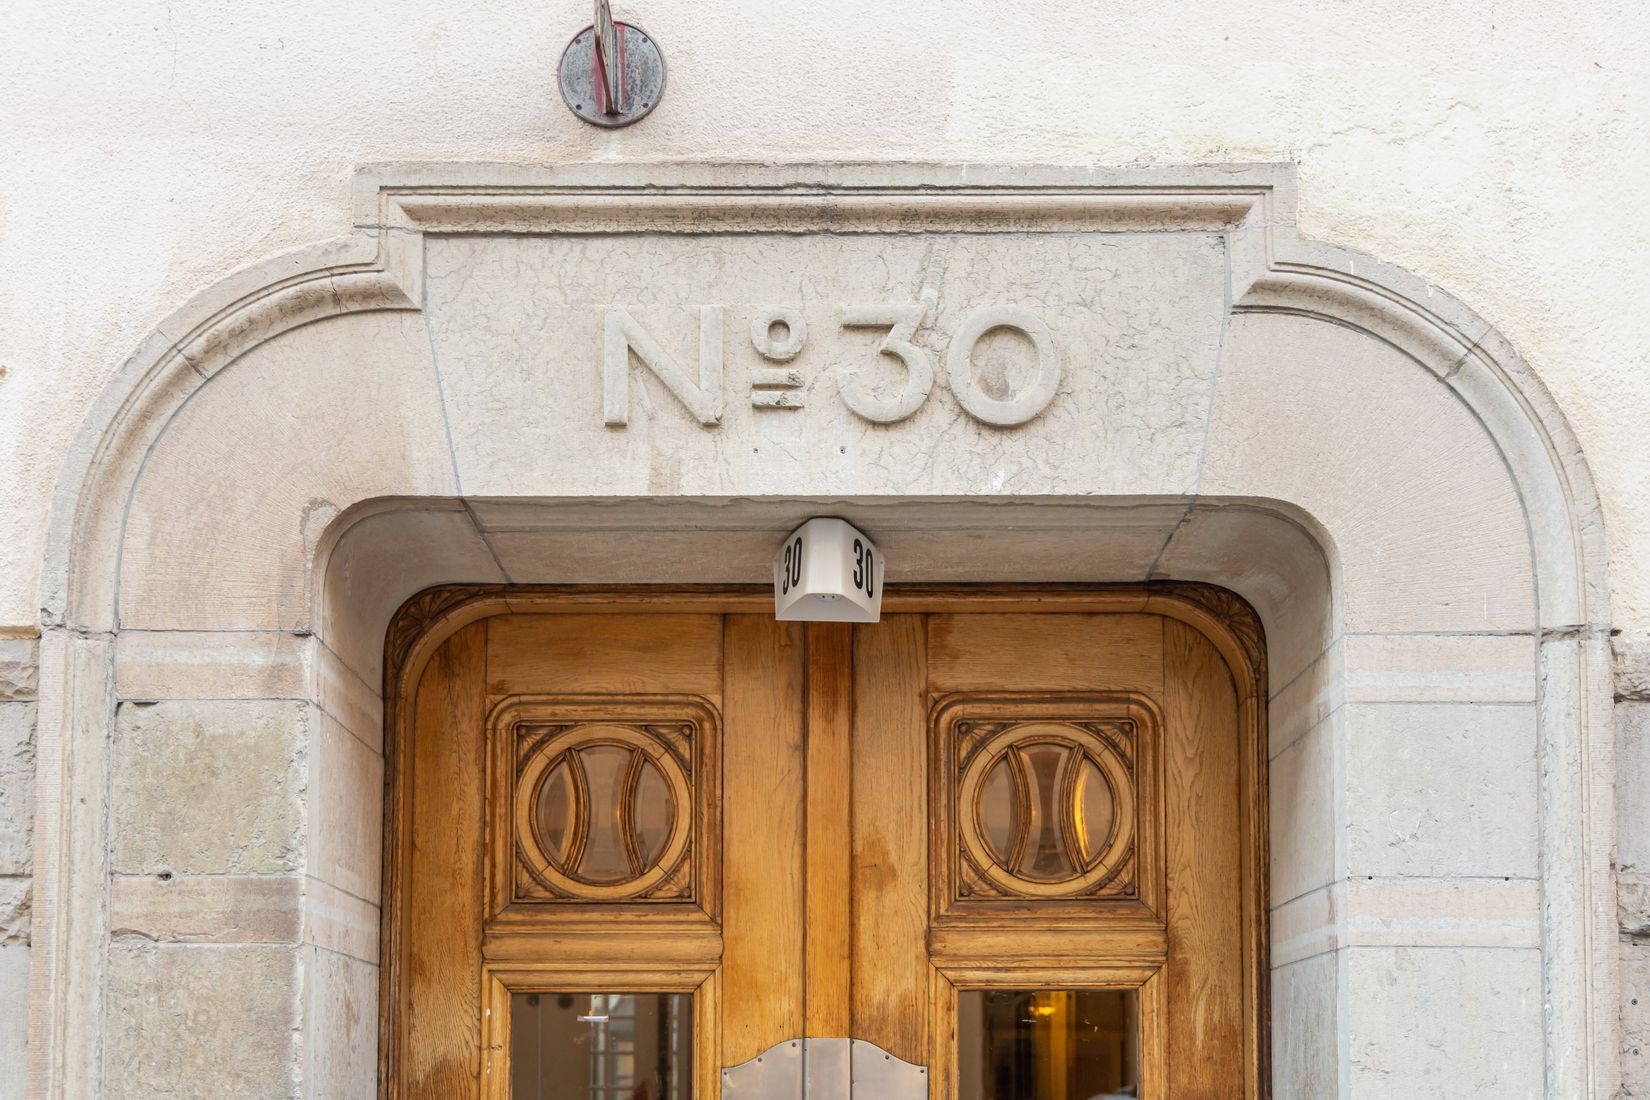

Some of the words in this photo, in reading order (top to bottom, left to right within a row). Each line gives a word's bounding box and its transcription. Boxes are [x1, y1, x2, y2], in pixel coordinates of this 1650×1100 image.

[837, 304, 1062, 426] 30
[783, 536, 802, 595] 30
[854, 538, 873, 598] 30
